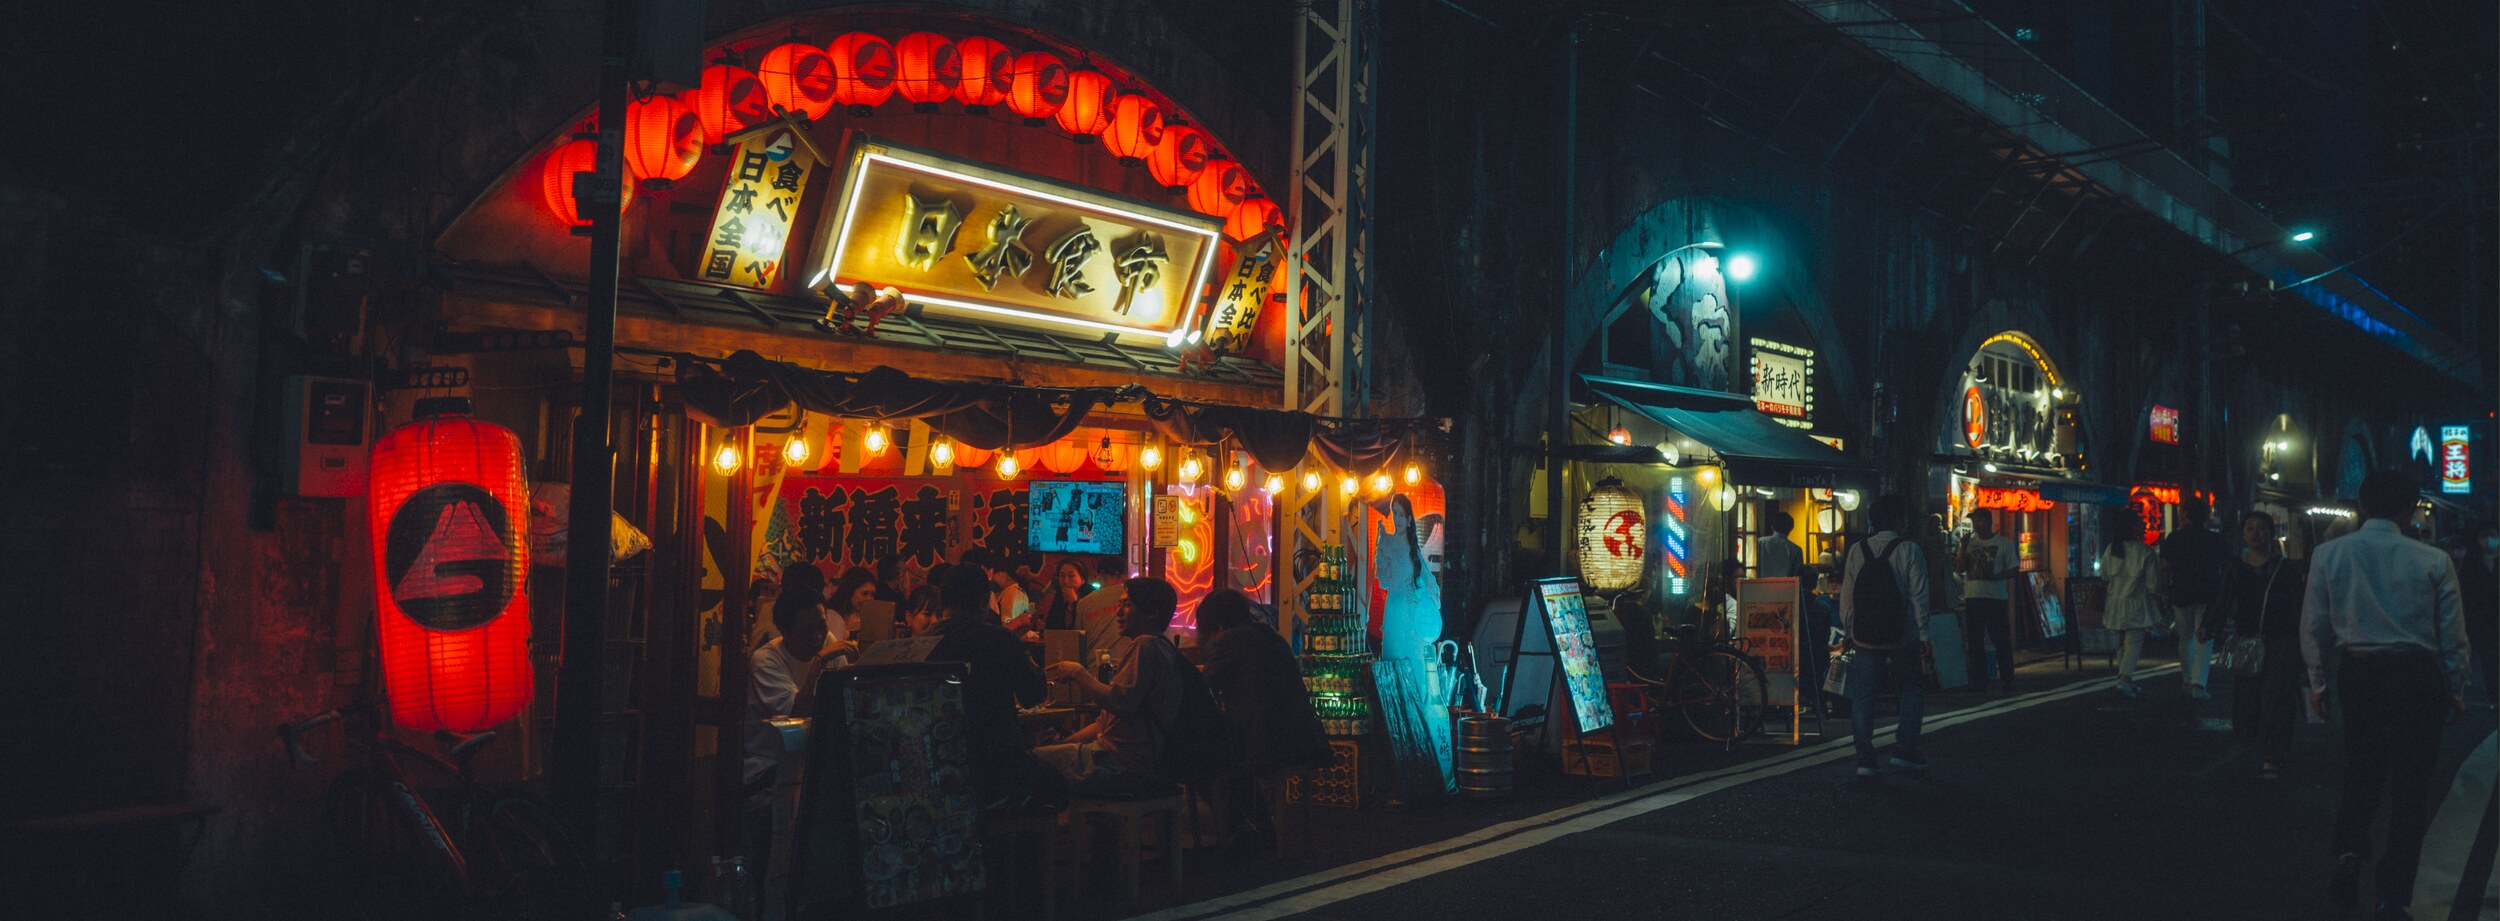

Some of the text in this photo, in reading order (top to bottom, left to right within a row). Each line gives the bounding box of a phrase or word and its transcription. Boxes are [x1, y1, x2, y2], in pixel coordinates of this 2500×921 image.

[705, 149, 768, 280] 日本全国
[1218, 256, 1257, 326] 日本全
[1761, 362, 1801, 402] 新時代
[2445, 443, 2467, 479] 王将
